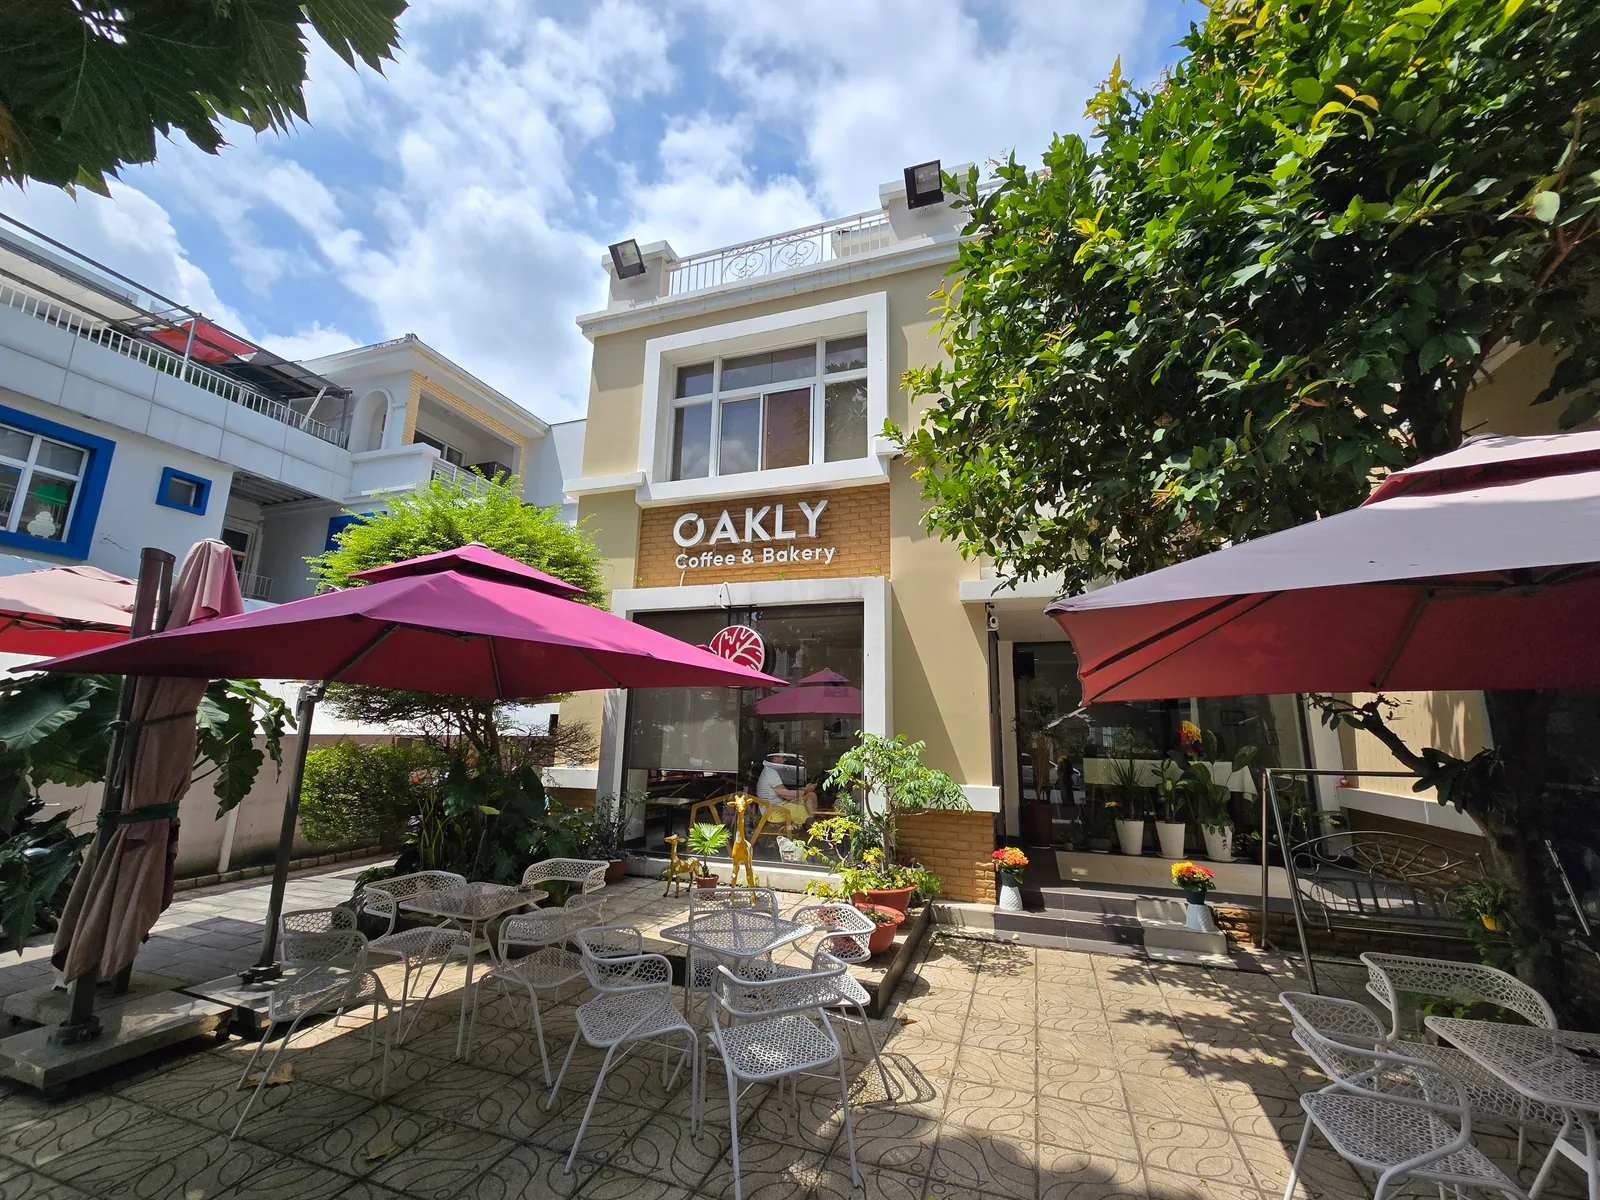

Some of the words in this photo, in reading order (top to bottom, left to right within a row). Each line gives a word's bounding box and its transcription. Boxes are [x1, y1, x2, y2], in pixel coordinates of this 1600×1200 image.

[673, 500, 828, 547] OAKLY
[675, 551, 736, 569] Coffee
[741, 548, 755, 565] &
[763, 545, 836, 564] Bakery
